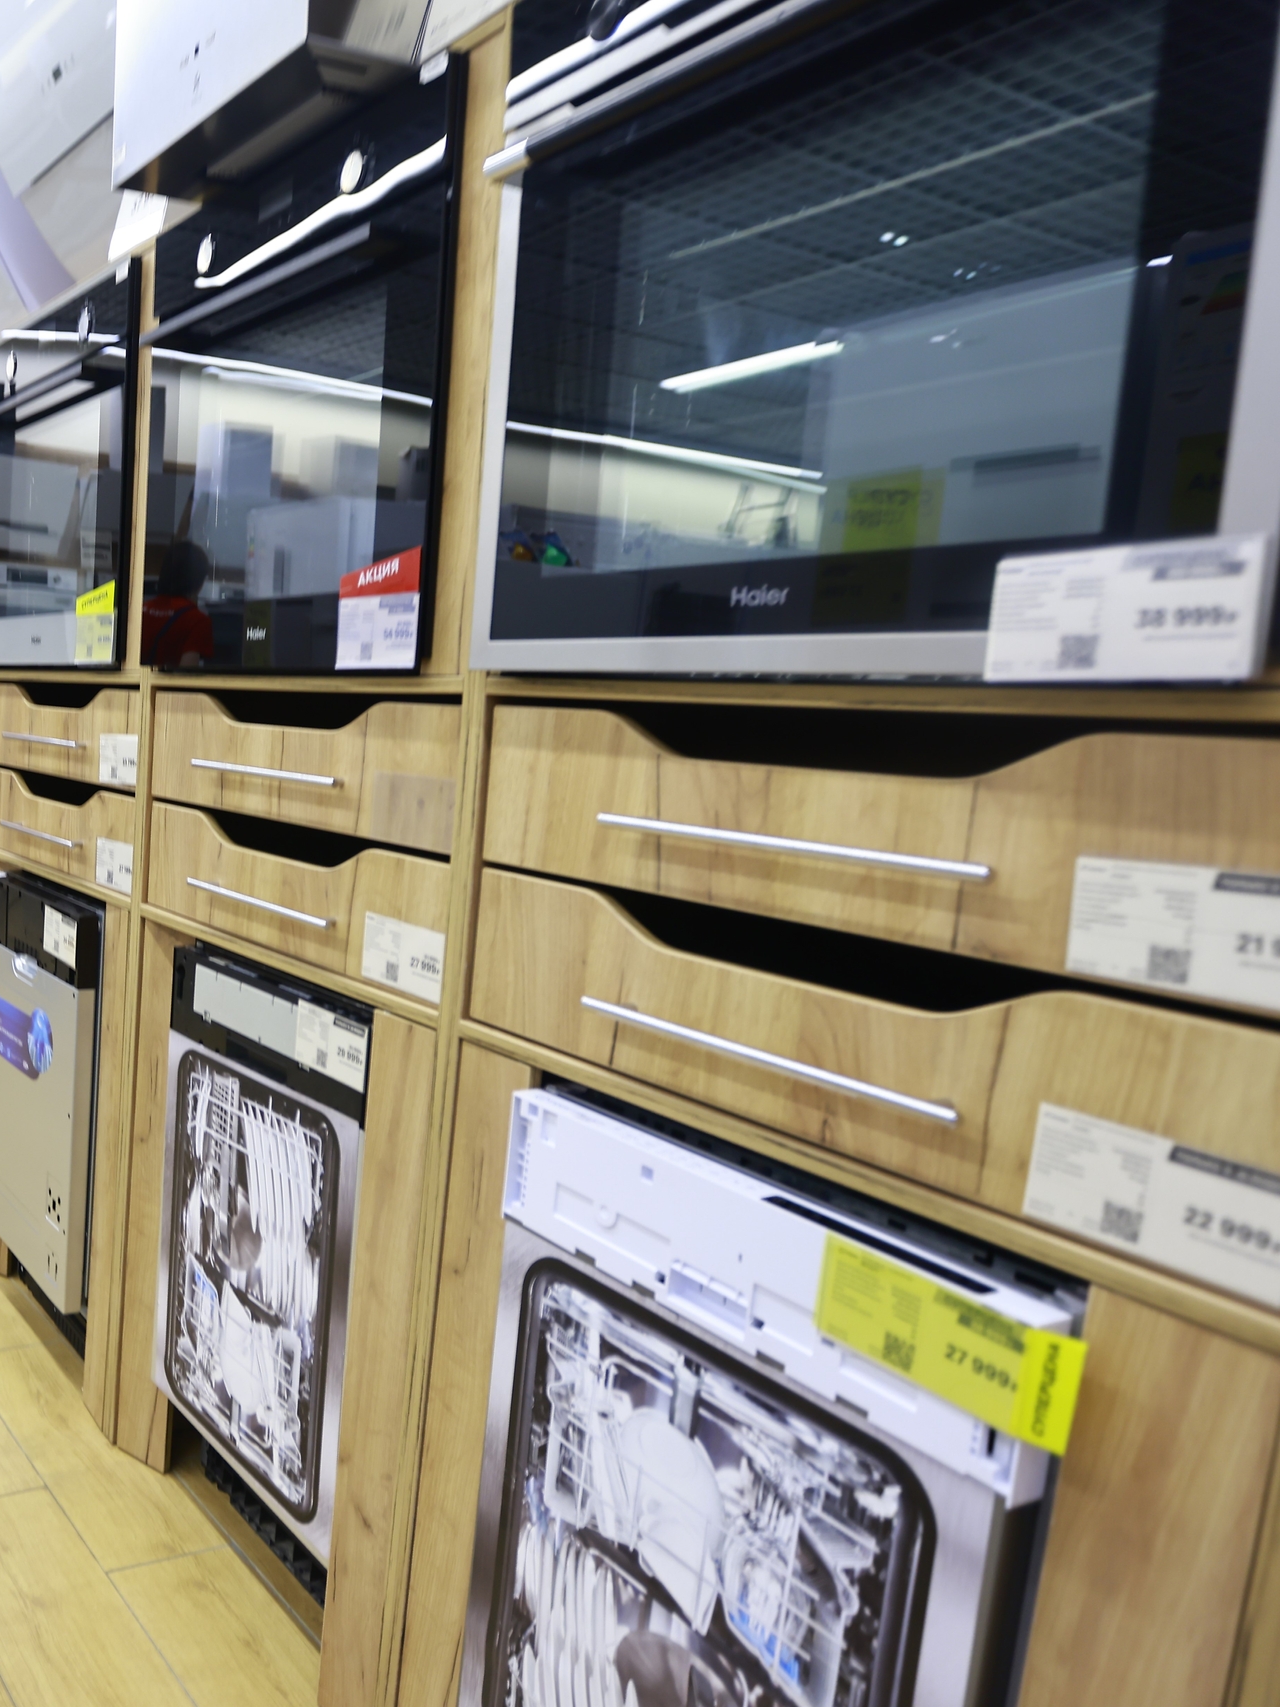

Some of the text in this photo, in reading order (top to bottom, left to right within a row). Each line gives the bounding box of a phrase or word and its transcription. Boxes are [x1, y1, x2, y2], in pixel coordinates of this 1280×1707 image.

[357, 557, 400, 588] АКЦИЯ
[729, 583, 790, 607] Haier
[246, 625, 267, 641] Haier
[1183, 1205, 1214, 1231] 22
[945, 1342, 968, 1365] 27
